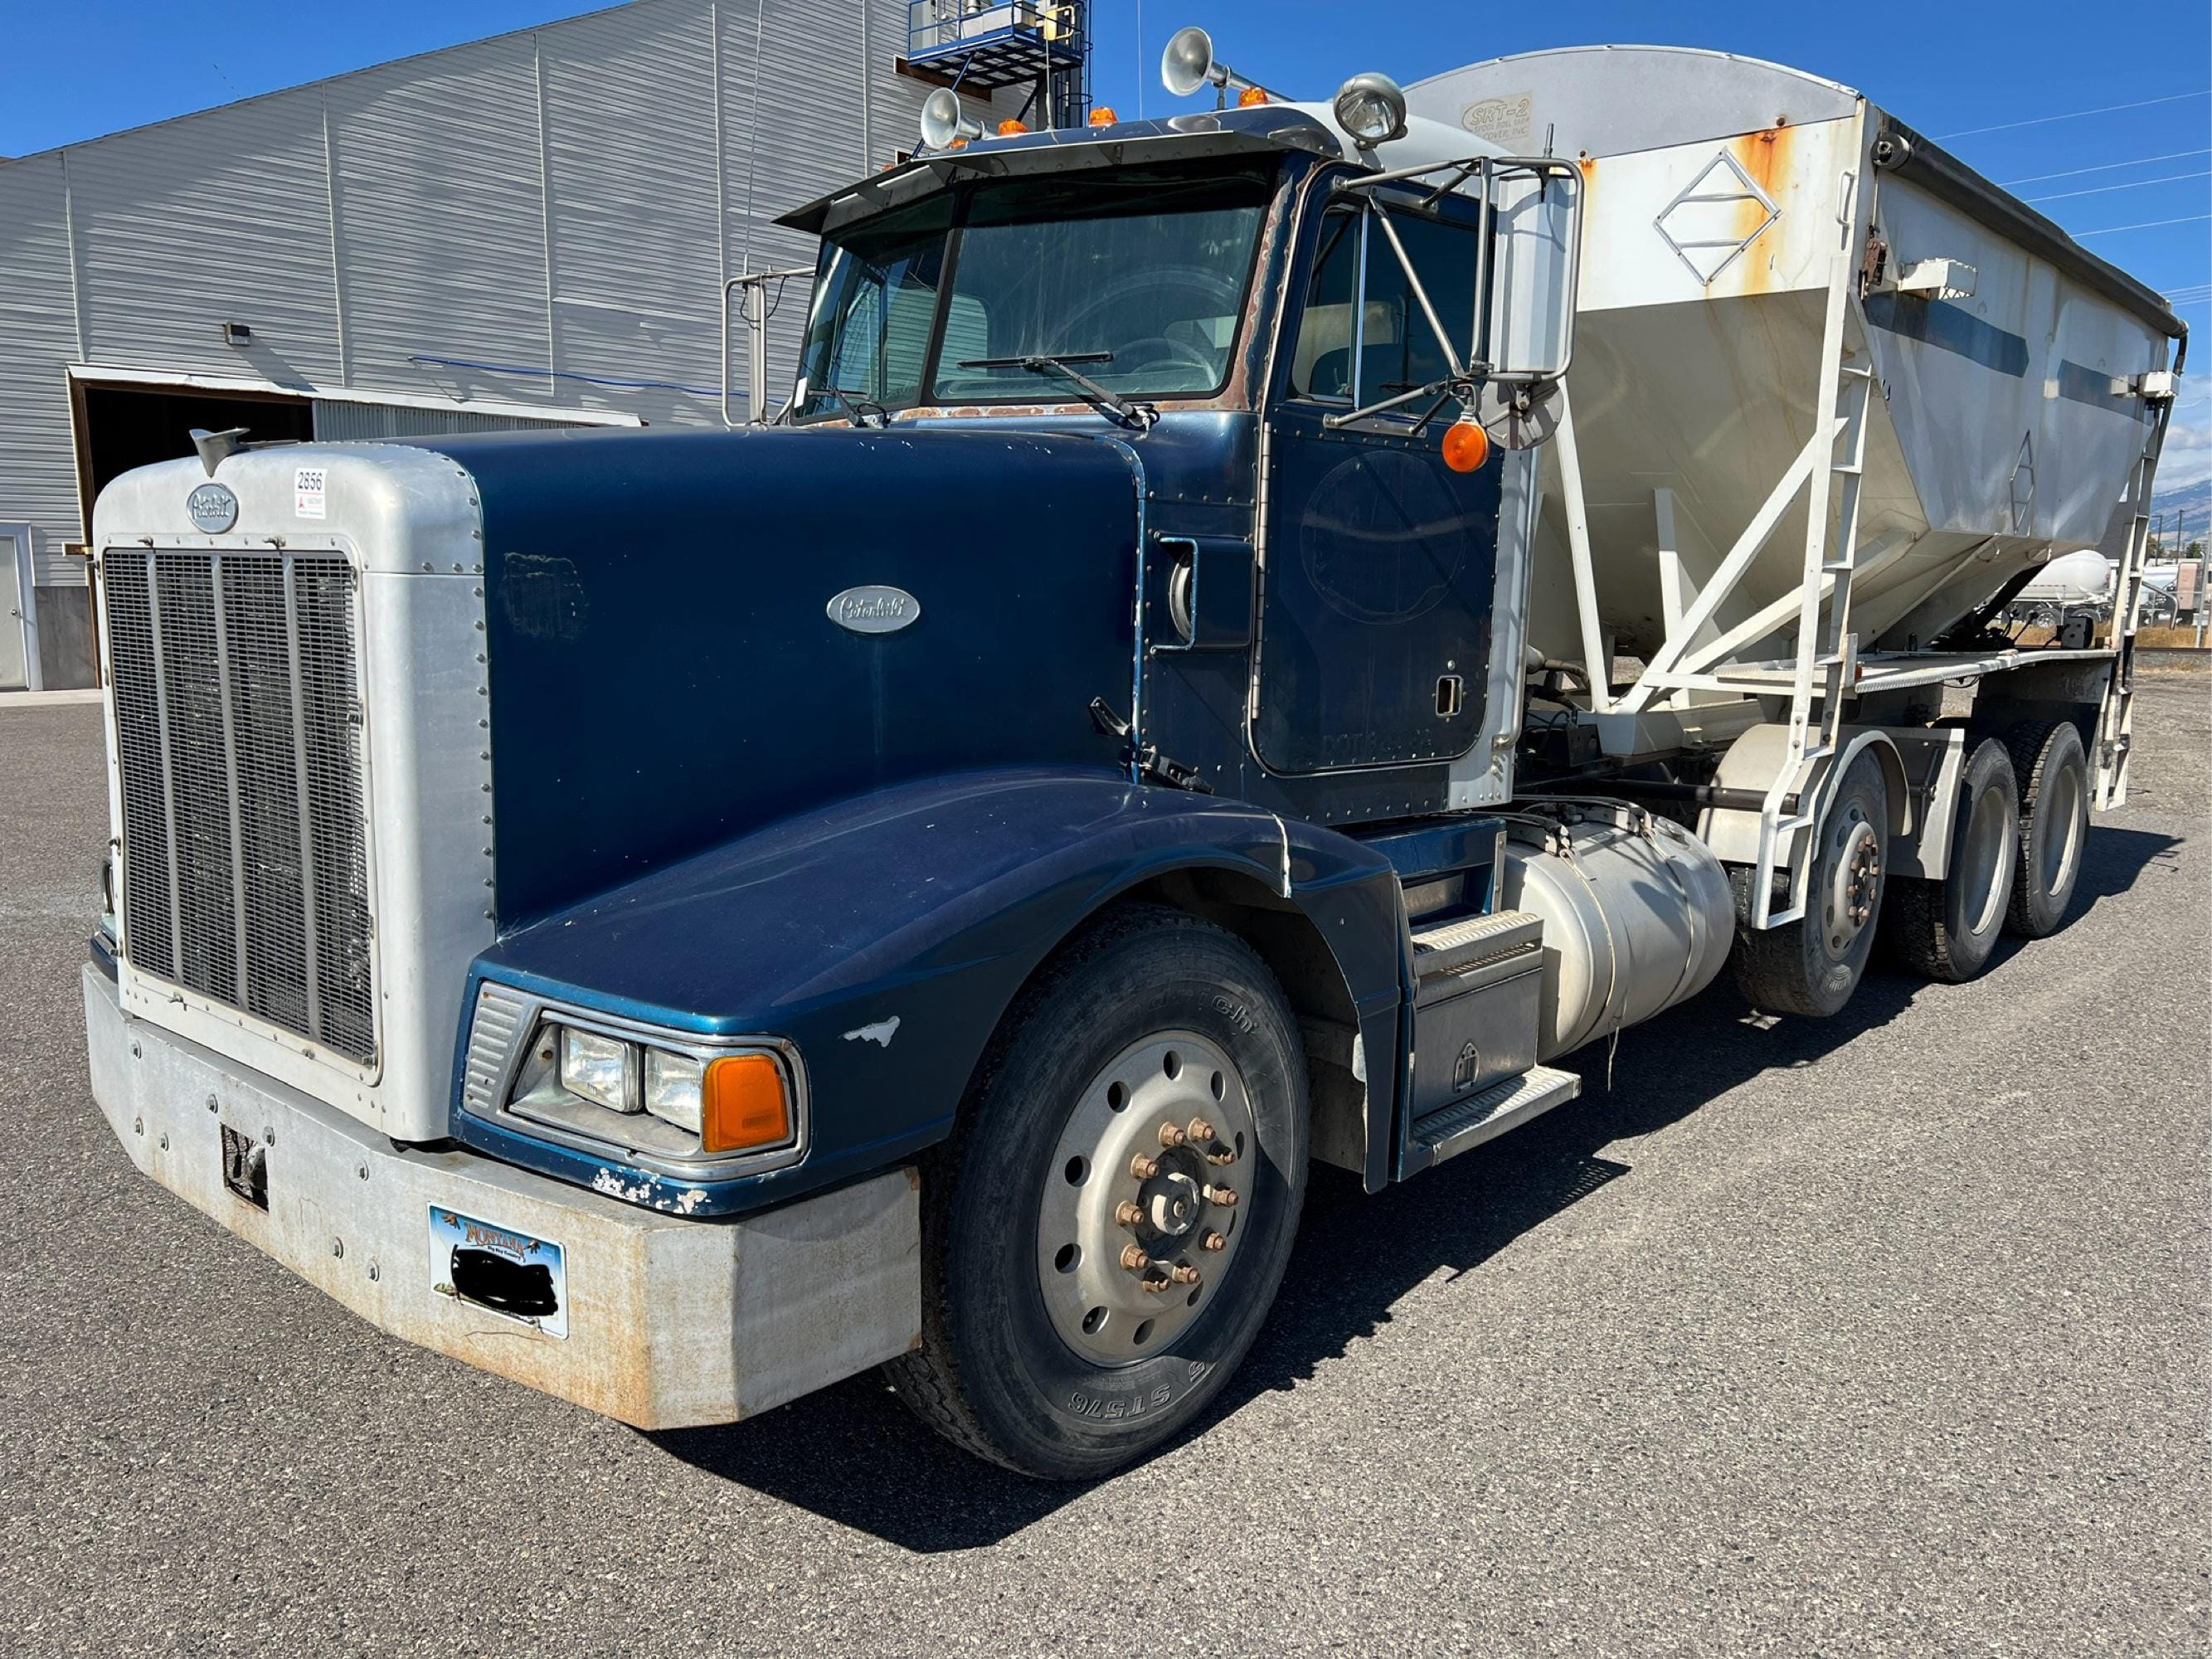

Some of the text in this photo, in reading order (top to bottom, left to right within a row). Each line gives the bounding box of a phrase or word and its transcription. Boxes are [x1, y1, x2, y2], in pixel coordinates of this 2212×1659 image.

[1471, 98, 1529, 125] SRT-2
[298, 471, 323, 491] 2856
[840, 596, 906, 621] Peterbilt
[464, 1221, 526, 1262] MONTANA
